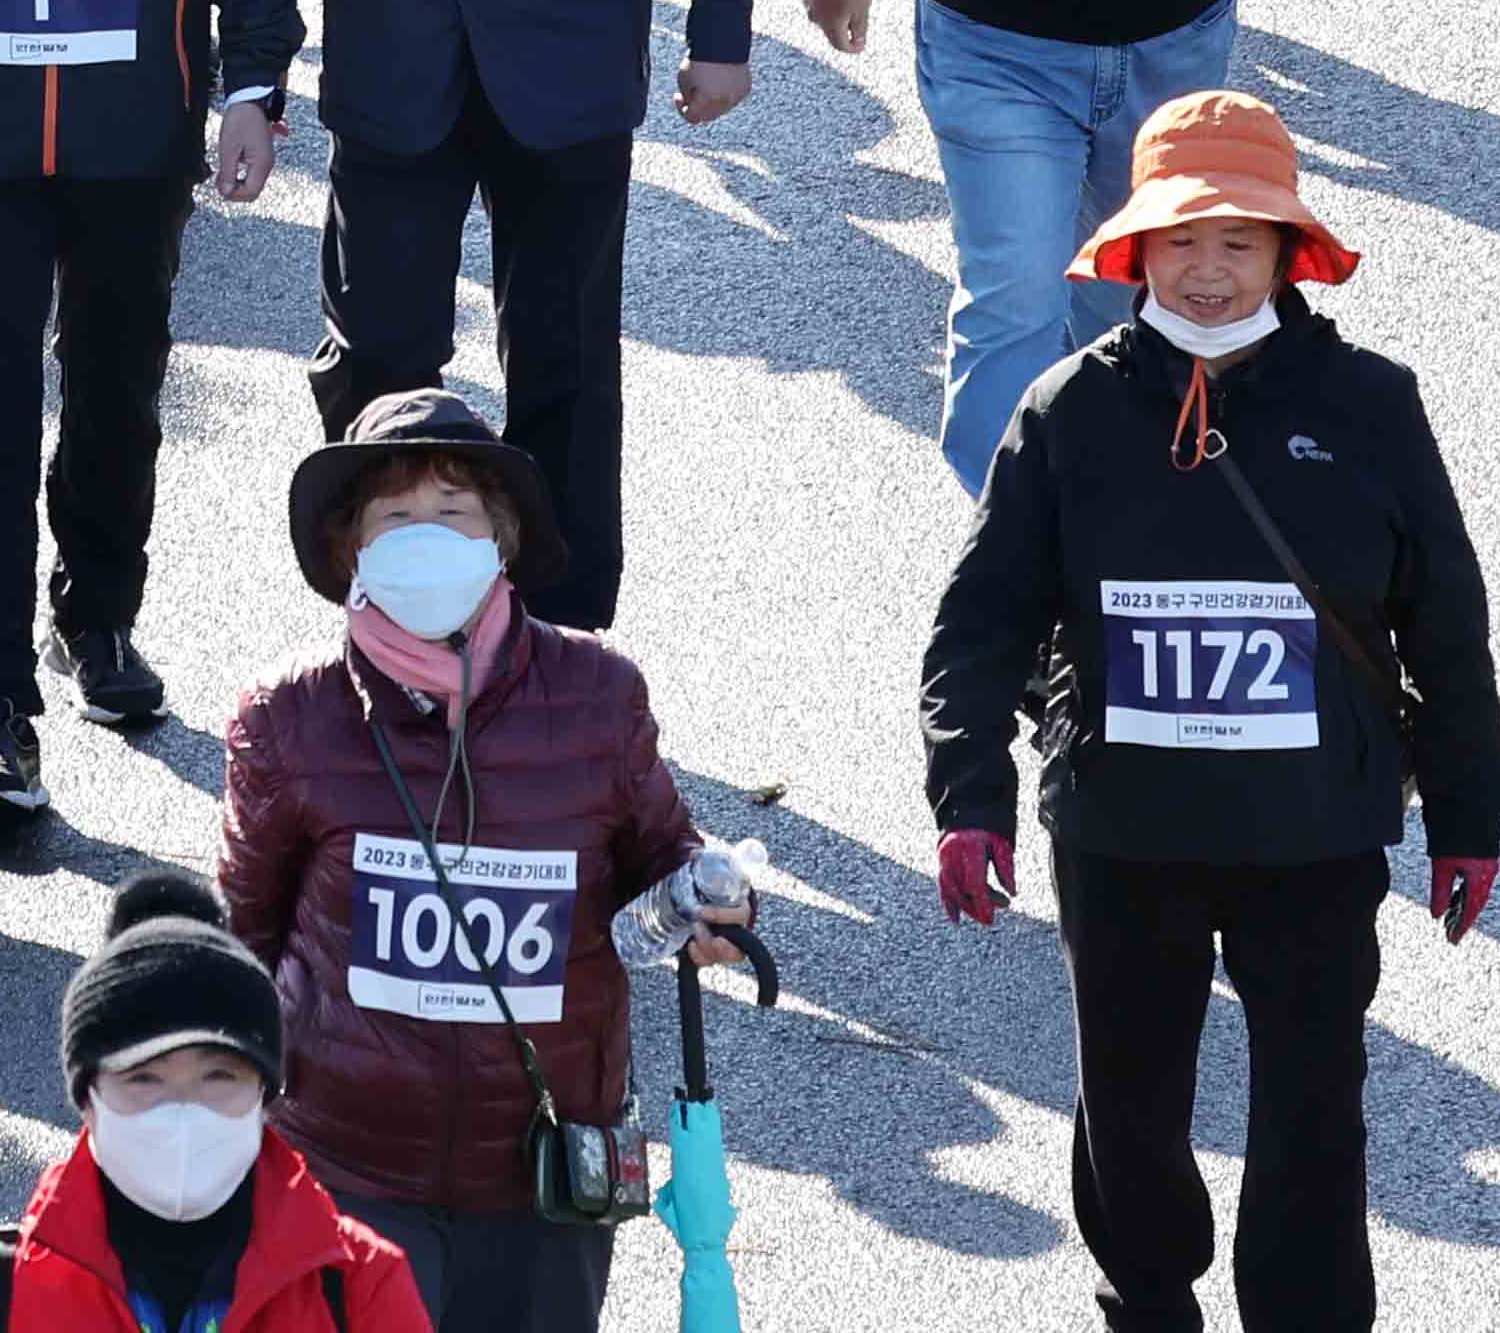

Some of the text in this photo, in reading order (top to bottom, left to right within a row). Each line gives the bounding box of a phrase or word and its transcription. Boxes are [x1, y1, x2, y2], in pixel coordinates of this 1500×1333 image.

[1111, 591, 1152, 609] 2023
[1131, 629, 1290, 700] 1172
[362, 846, 407, 868] 2023
[367, 886, 553, 975] 1006
